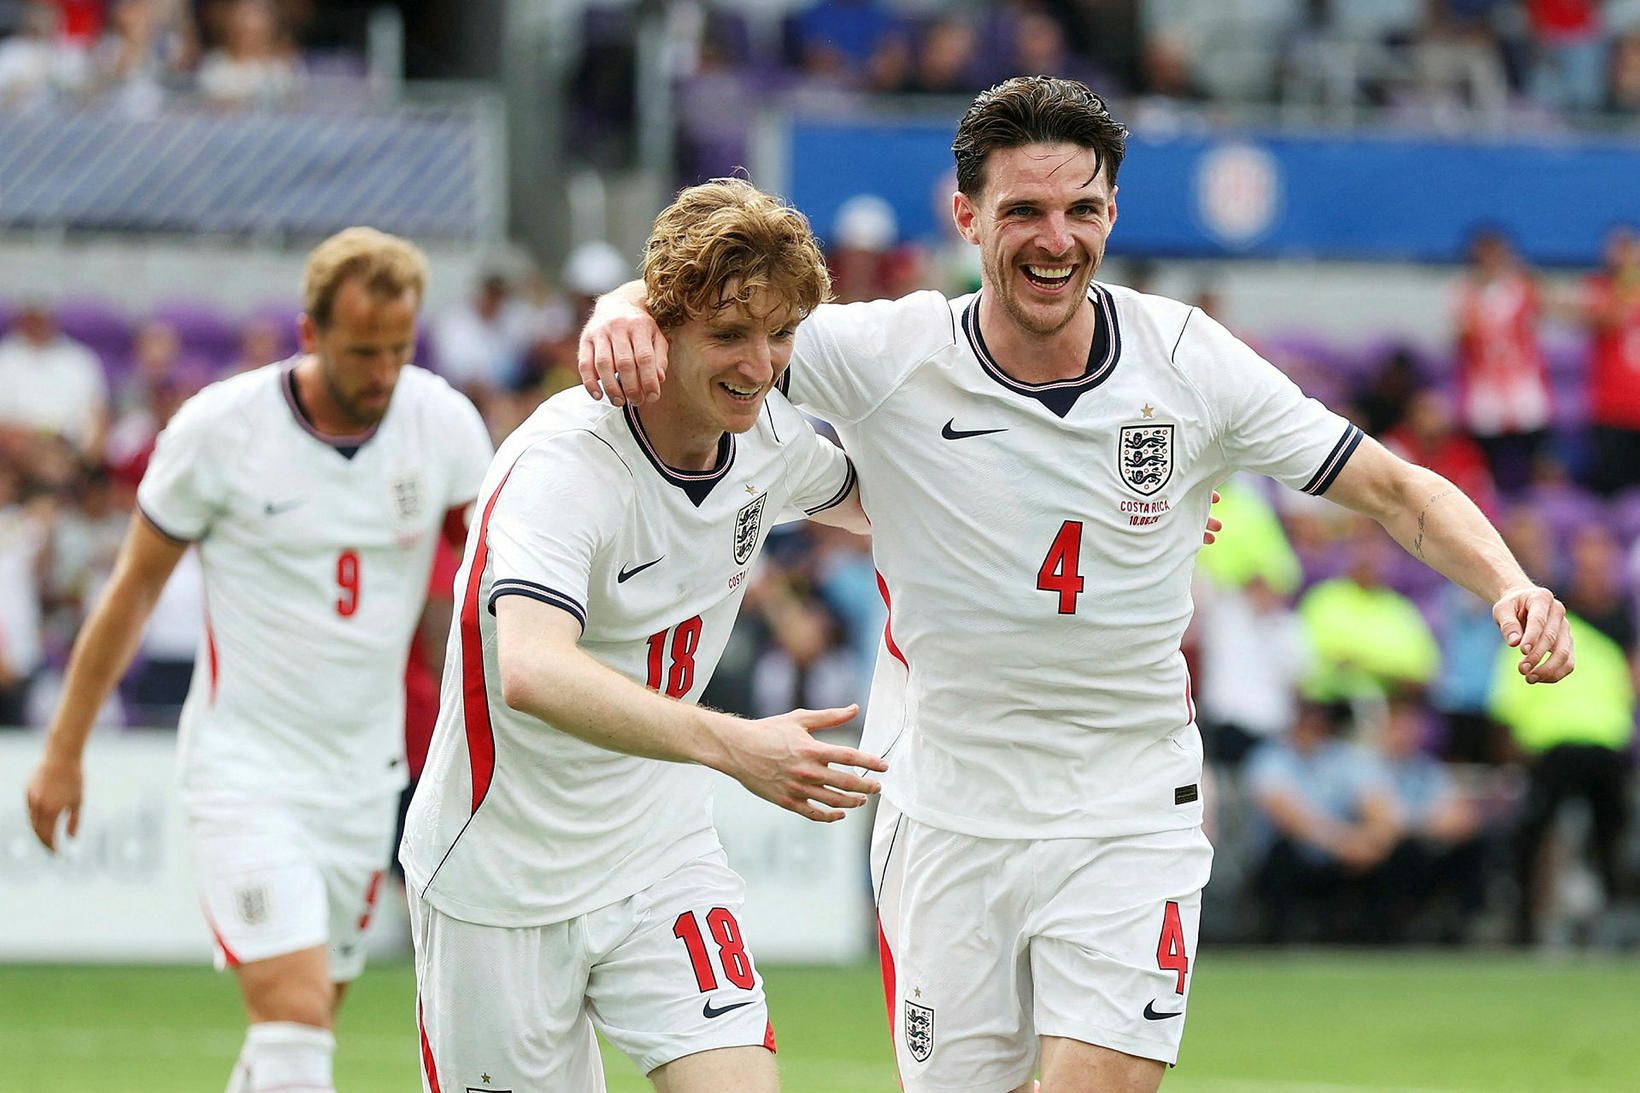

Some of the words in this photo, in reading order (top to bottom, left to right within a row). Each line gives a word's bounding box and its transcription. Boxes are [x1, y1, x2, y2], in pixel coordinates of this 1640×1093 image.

[1120, 500, 1149, 513] COSTA
[1151, 500, 1170, 513] RICA
[336, 550, 359, 618] 9
[1036, 520, 1084, 614] 4
[646, 614, 703, 699] 18
[672, 907, 755, 993] 18
[1156, 901, 1188, 995] 4
